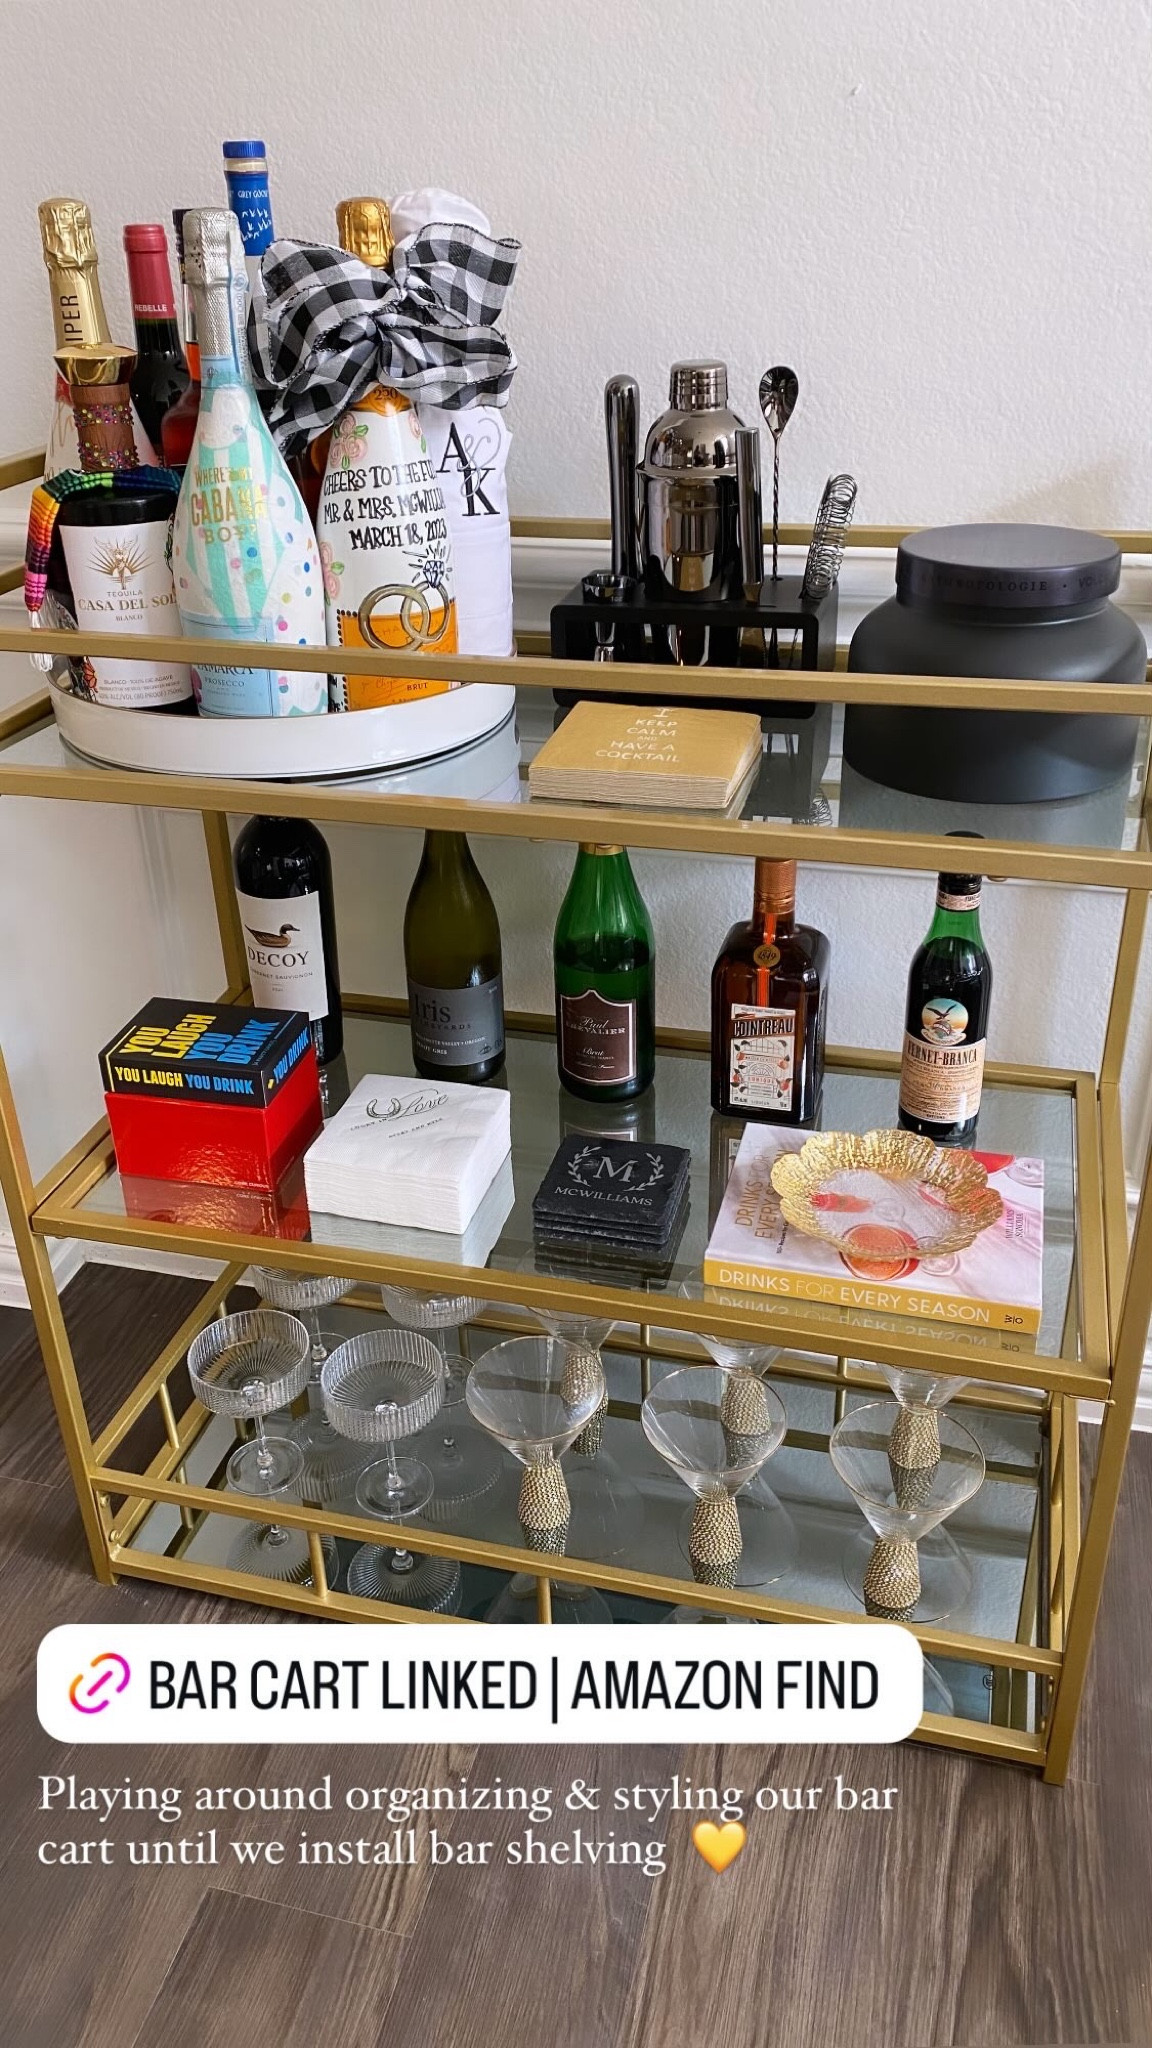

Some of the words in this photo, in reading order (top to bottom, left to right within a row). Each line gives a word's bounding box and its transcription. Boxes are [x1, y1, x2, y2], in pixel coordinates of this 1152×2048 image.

[134, 303, 168, 313] REBELLE
[323, 468, 368, 497] CHEERS
[369, 465, 392, 489] TO
[436, 421, 469, 474] A
[457, 467, 501, 517] K
[191, 485, 268, 526] CABANA
[324, 502, 342, 525] MR
[343, 498, 354, 522] &
[358, 495, 397, 521] MRS.
[348, 525, 402, 551] MARCH
[424, 517, 448, 542] 2023
[78, 599, 115, 612] CASA
[119, 599, 148, 611] DEL
[106, 590, 144, 598] TEQUILA
[204, 676, 245, 688] PROSECCO
[407, 682, 428, 692] BRUT
[626, 727, 678, 737] CALM
[635, 719, 678, 727] KEEP
[595, 749, 681, 763] COCKTAIL
[610, 740, 659, 751] HAVE
[662, 743, 676, 752] A
[247, 945, 309, 968] DECOY
[413, 993, 451, 1024] Iris
[118, 1026, 170, 1055] YOU
[150, 1013, 218, 1060] LAUGH
[217, 1018, 281, 1065] DRINK
[734, 1018, 794, 1037] COINTREAU
[183, 1032, 235, 1060] YOU
[272, 1059, 289, 1085] YOU
[287, 1026, 310, 1068] DRINK
[114, 1066, 140, 1083] YOU
[143, 1070, 184, 1088] LAUGH
[185, 1073, 211, 1091] YOU
[213, 1076, 255, 1095] DRINK
[593, 1155, 639, 1183] M
[554, 1186, 654, 1206] MCWILLIAMS
[735, 1180, 764, 1227] DRINKS
[754, 1196, 781, 1240] EVERY
[719, 1268, 790, 1293] DRINKS
[796, 1279, 834, 1298] FOR
[840, 1286, 902, 1311] EVERY
[907, 1297, 990, 1323] SEASON
